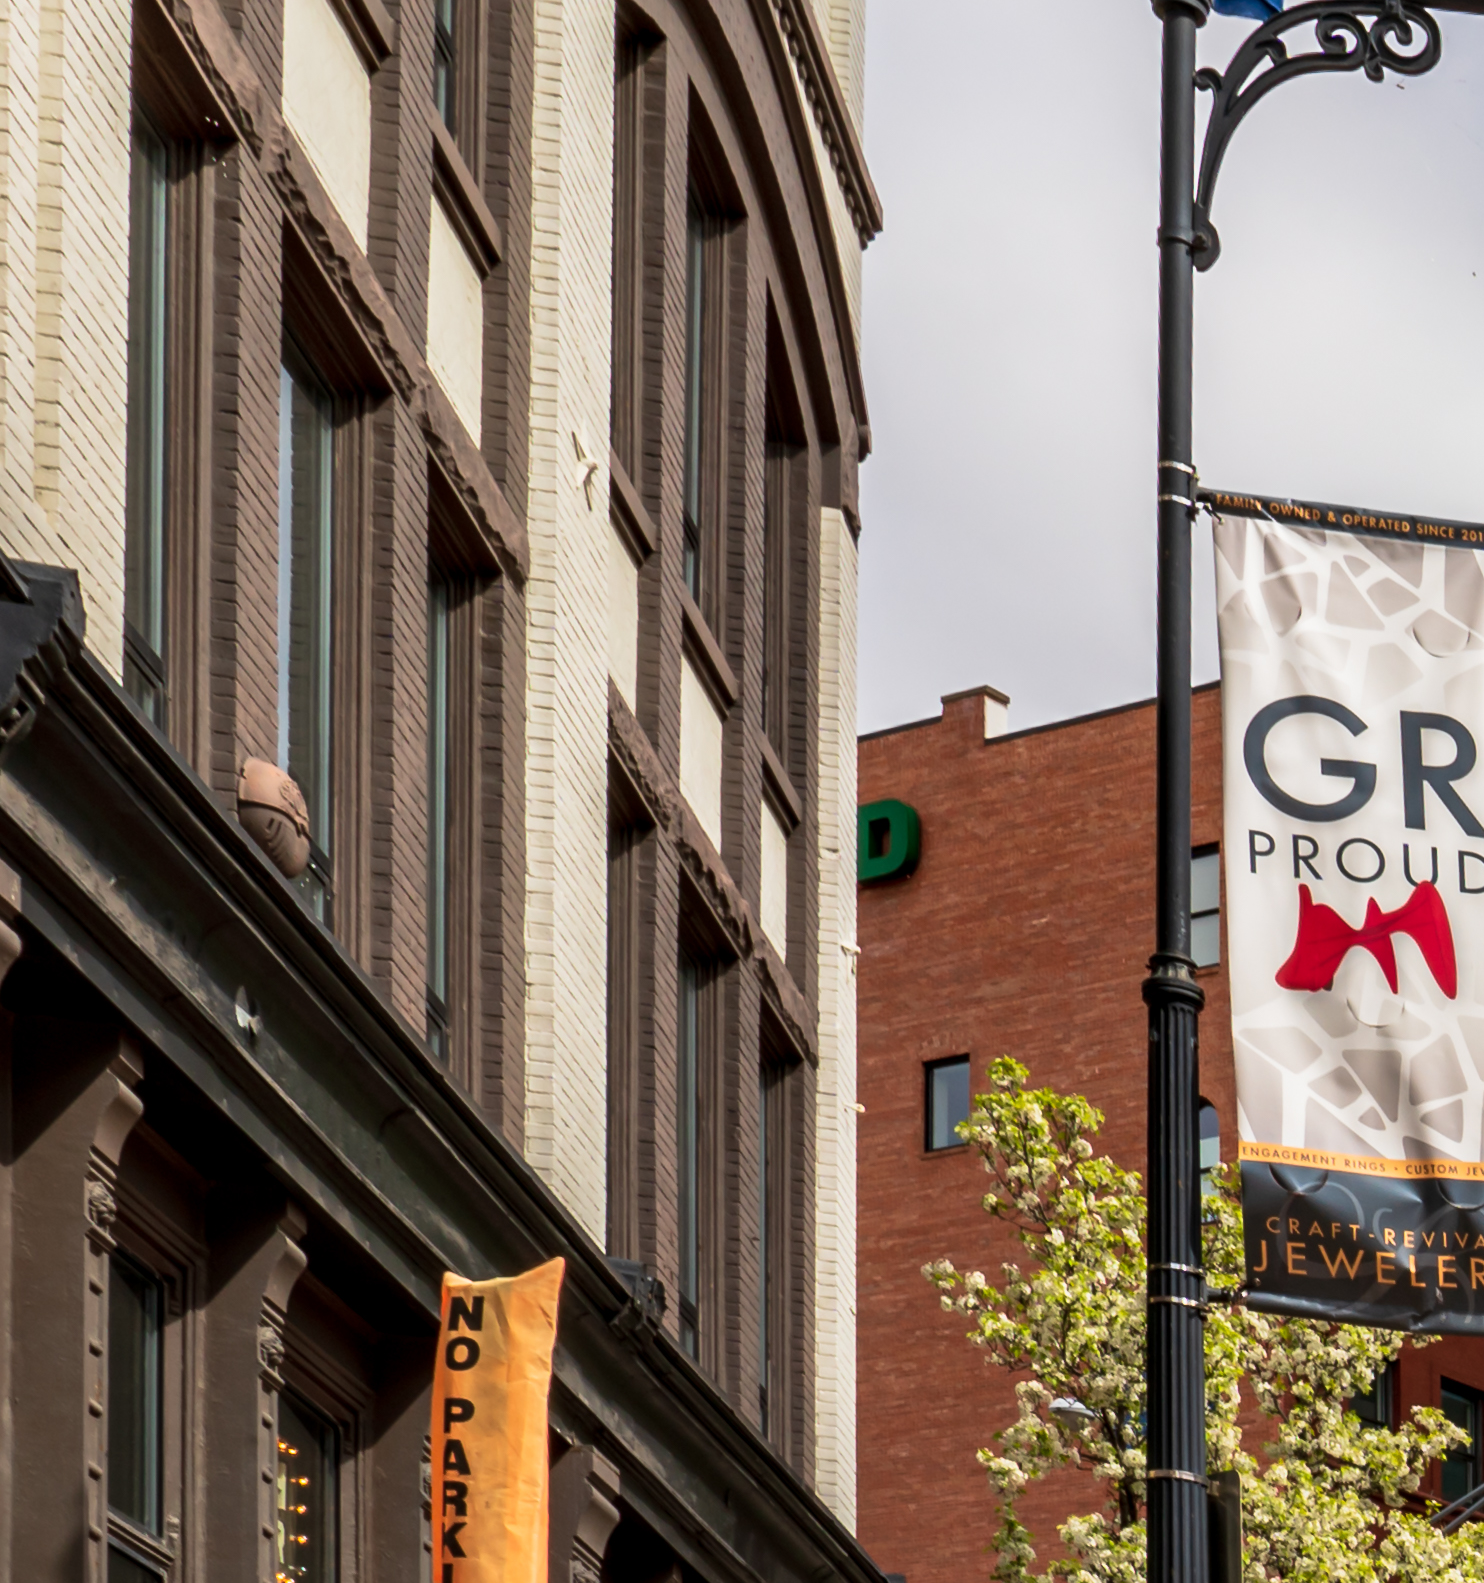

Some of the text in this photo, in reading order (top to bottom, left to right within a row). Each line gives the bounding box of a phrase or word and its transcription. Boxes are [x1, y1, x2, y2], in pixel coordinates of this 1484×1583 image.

[1215, 493, 1262, 511] FAMILY
[1269, 501, 1321, 522] OWNED
[1327, 511, 1337, 523] &
[1342, 513, 1410, 533] OPERATED
[1416, 522, 1455, 539] SINCE
[1242, 1146, 1336, 1166] ENGAGEMENT
[1344, 1158, 1386, 1173] RINGS
[1405, 1164, 1458, 1175] CUSTOM
[443, 1295, 484, 1372] NO
